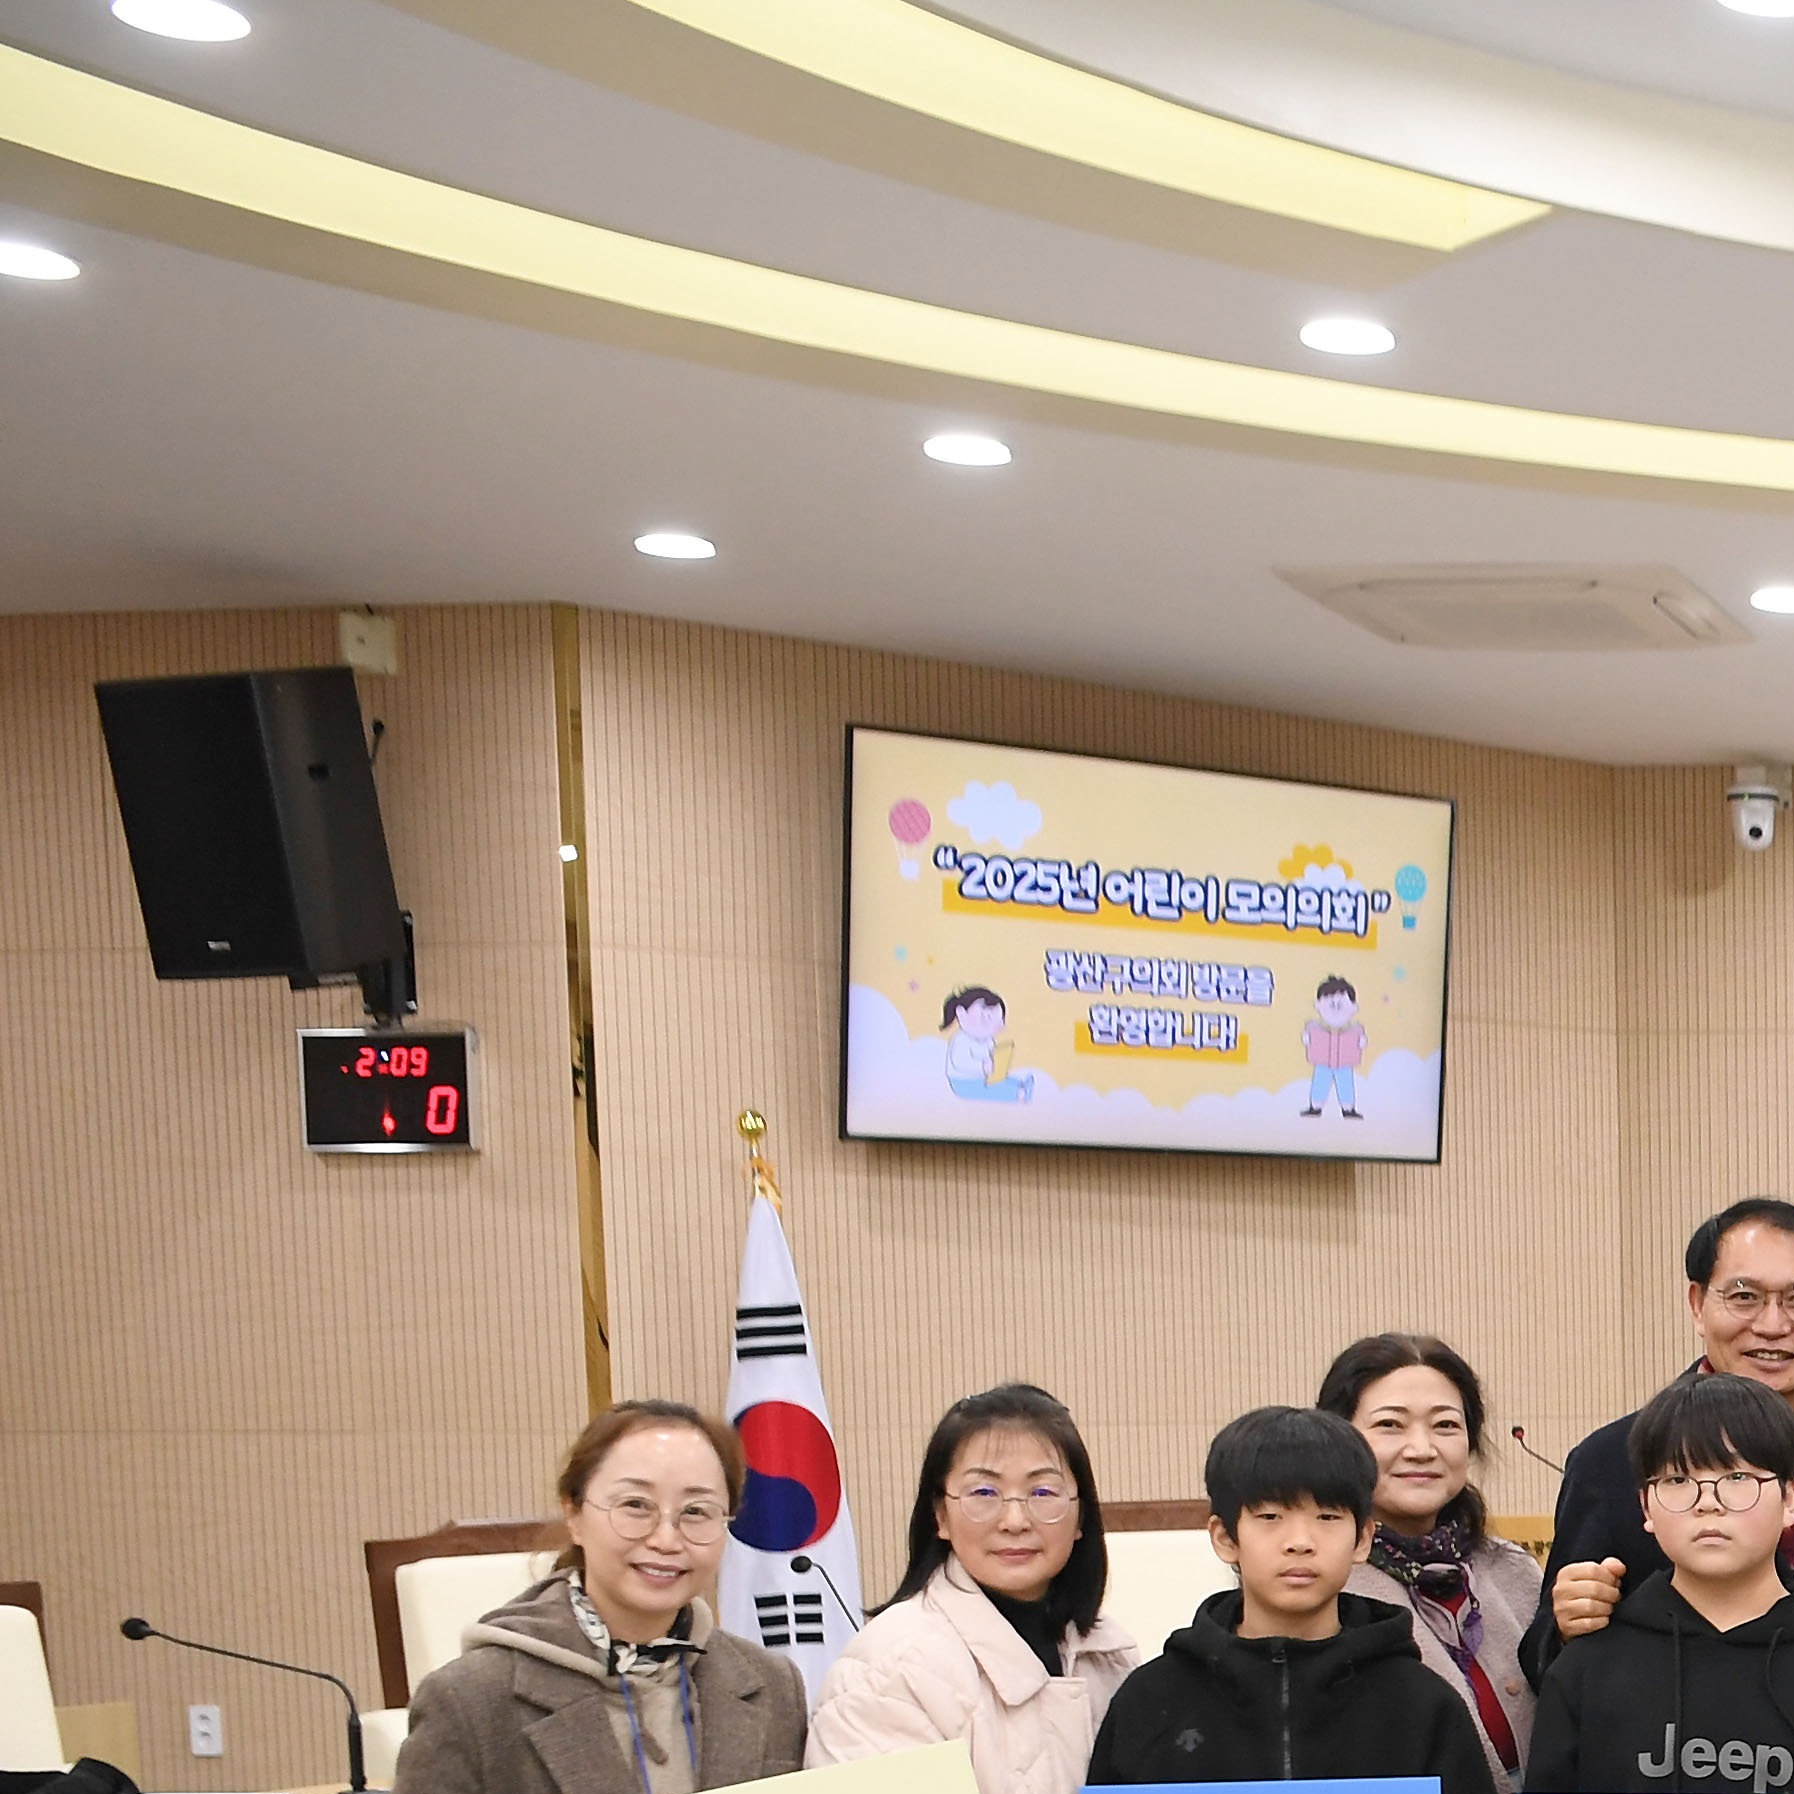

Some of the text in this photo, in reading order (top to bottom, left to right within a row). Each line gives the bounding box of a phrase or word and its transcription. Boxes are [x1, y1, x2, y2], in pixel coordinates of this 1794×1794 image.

[1103, 868, 1220, 924] 어린이
[1044, 949, 1274, 1007] 광산구의회 방문을
[1089, 1004, 1238, 1051] 환영합니다!
[355, 1046, 430, 1078] 2:09
[425, 1085, 459, 1135] 0
[1638, 1723, 1794, 1794] Jeep
